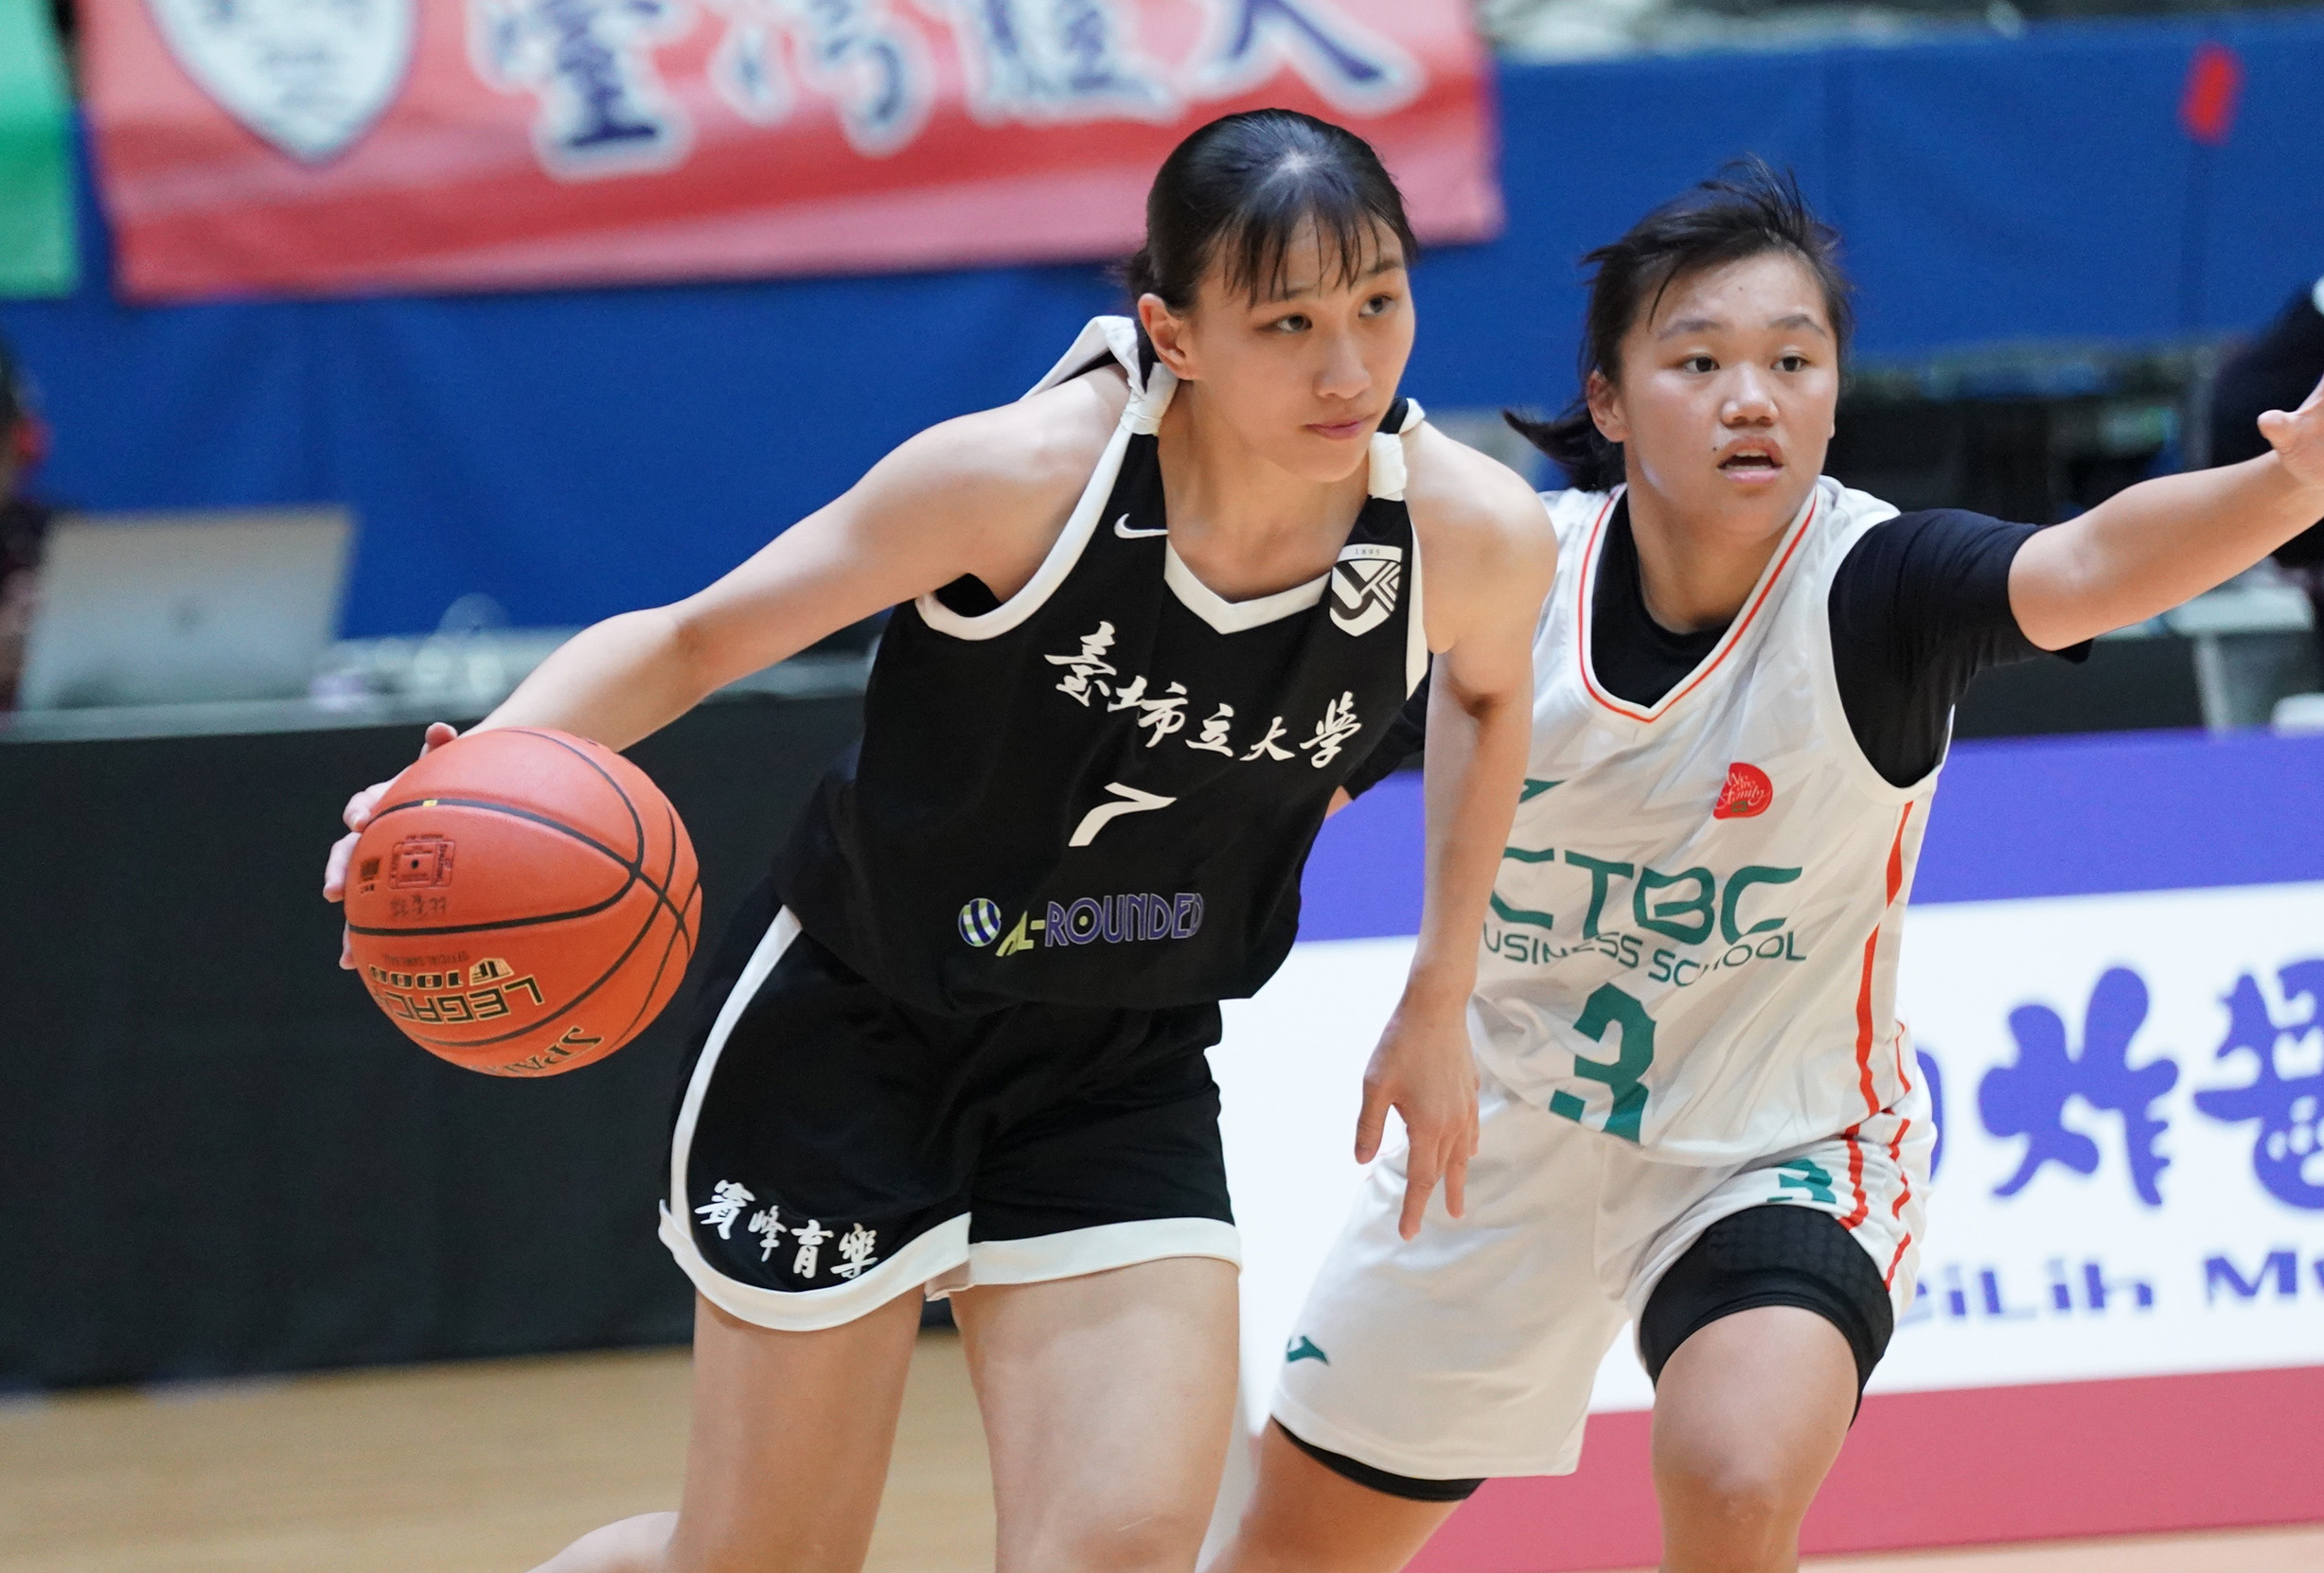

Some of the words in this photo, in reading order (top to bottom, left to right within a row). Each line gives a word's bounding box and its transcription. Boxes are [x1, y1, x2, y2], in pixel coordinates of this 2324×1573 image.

[1069, 783, 1177, 847] 7
[1489, 845, 1802, 946] CTBC
[1482, 922, 1643, 969] USINESS
[1549, 982, 1657, 1144] 3
